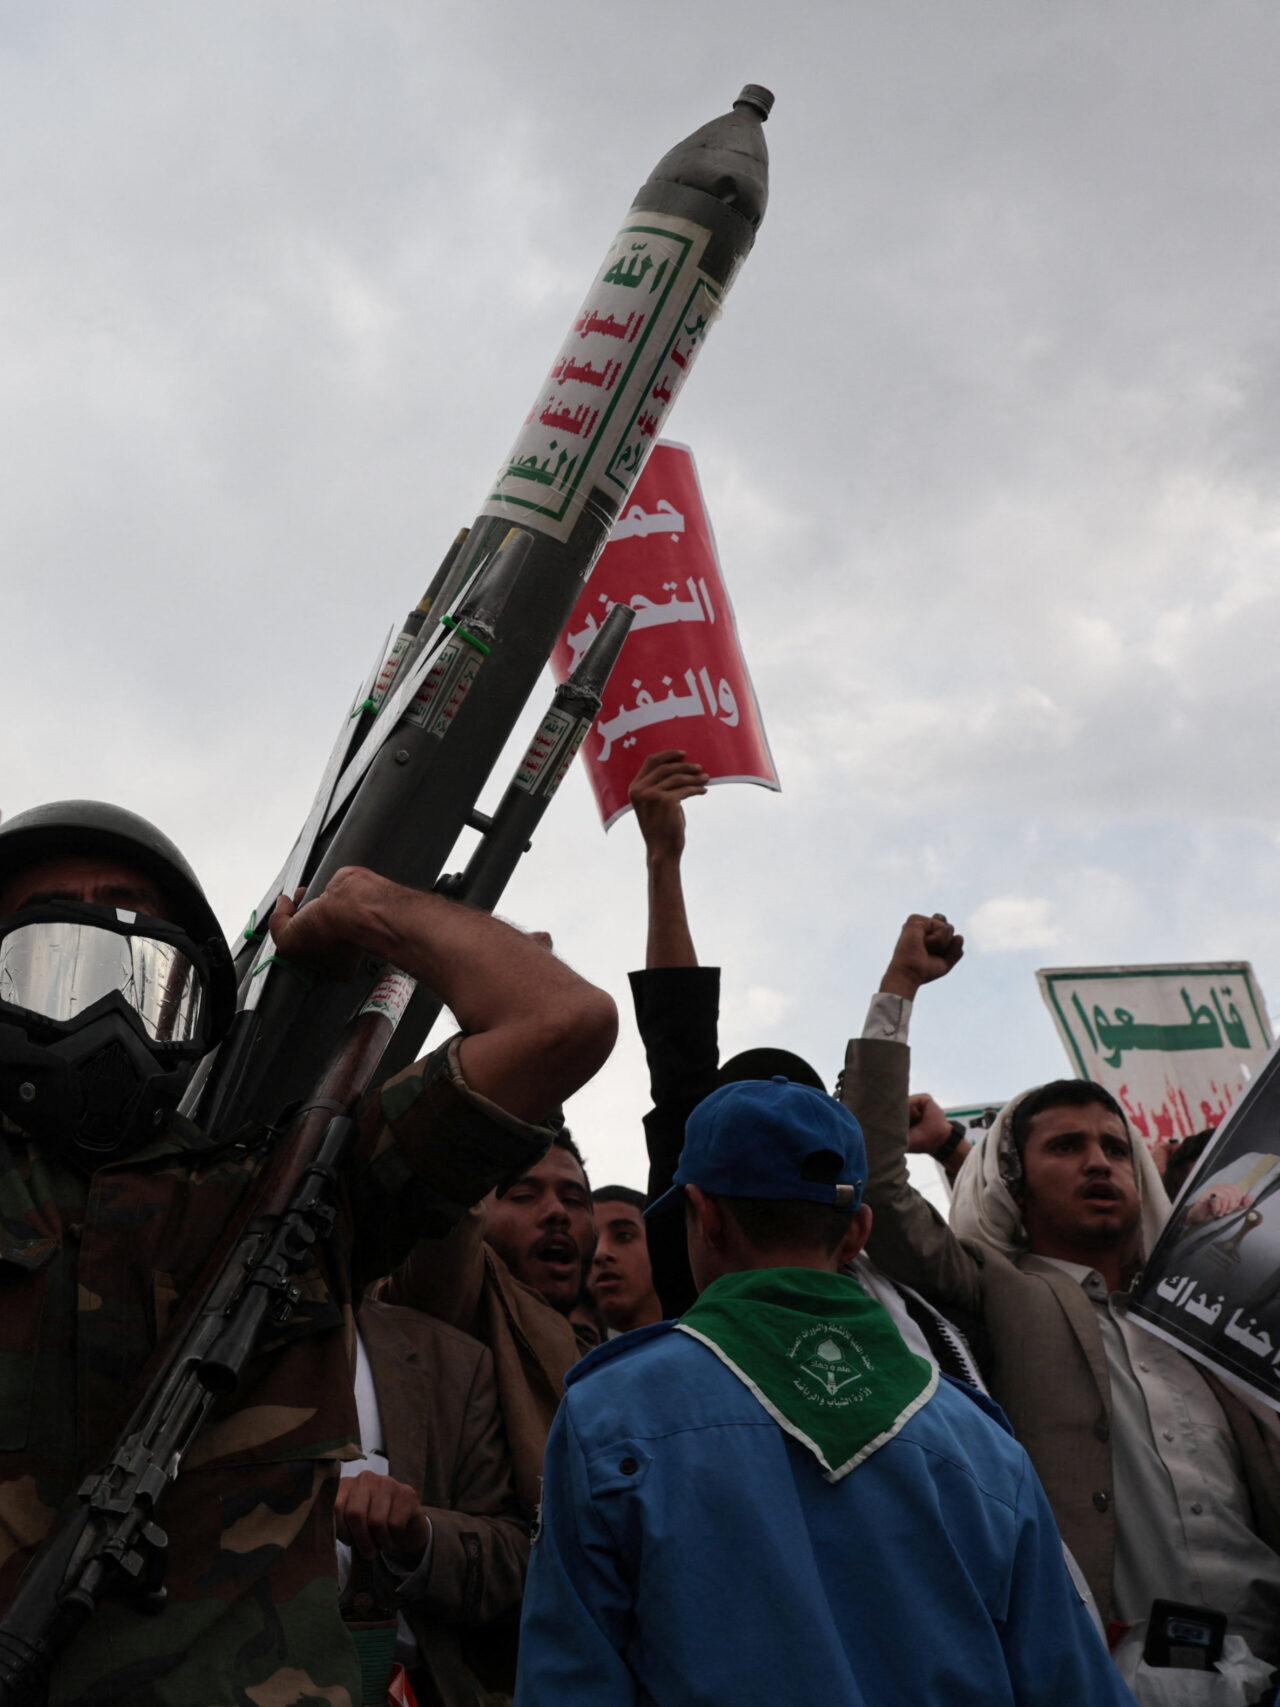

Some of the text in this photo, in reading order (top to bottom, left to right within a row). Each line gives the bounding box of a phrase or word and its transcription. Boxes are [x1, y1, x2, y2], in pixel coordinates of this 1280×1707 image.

[597, 667, 739, 761] والنفير
[1071, 986, 1252, 1068] قاطعوا
[1156, 1276, 1225, 1326] فداك
